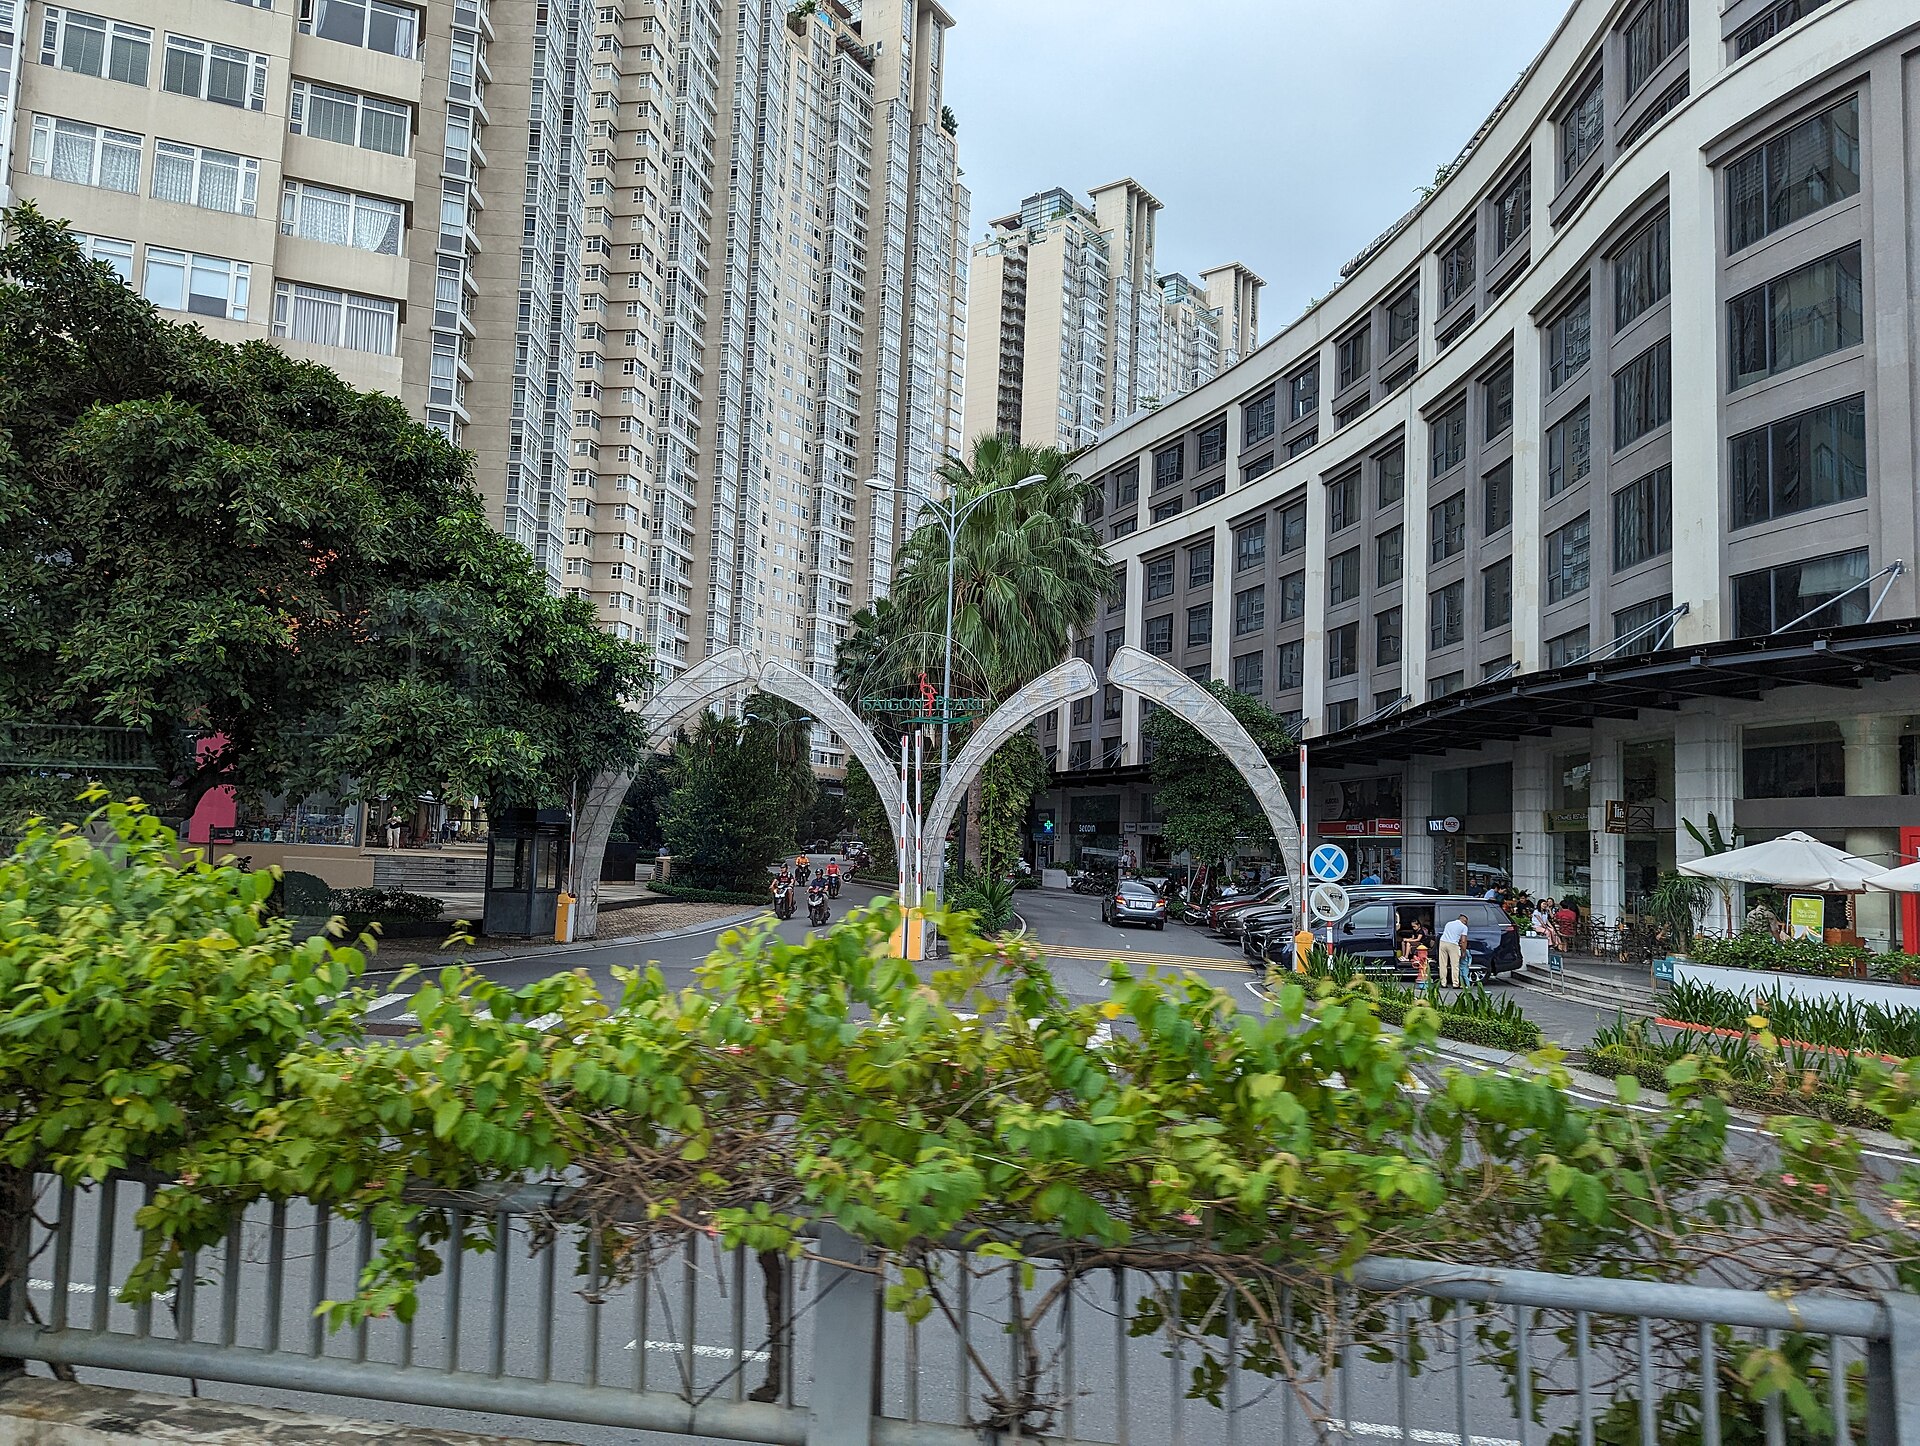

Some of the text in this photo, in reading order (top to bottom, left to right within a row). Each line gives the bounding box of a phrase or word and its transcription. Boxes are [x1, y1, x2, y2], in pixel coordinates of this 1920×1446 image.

[862, 695, 983, 711] SAIGON PEARL
[235, 829, 244, 837] D2
